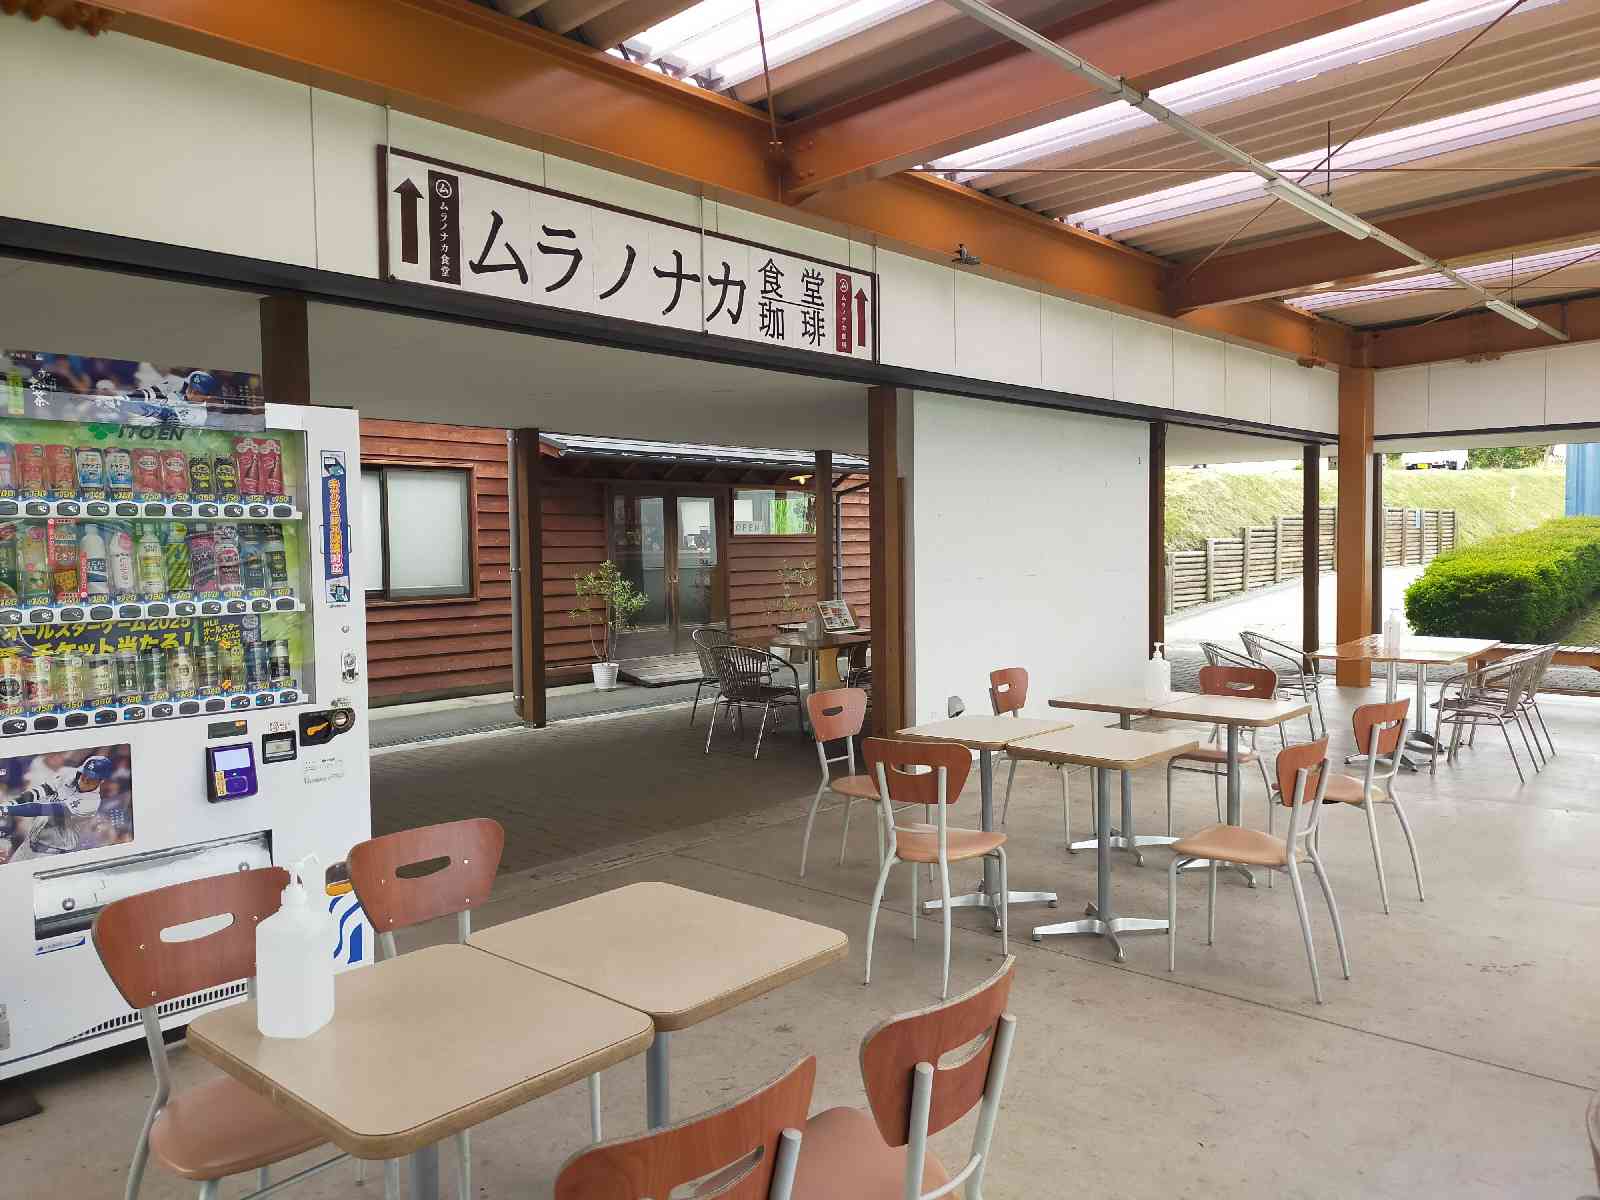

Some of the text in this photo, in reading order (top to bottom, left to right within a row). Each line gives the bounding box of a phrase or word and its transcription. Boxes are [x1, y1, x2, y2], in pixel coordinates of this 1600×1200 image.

[440, 201, 451, 277] ムラノナカ食堂
[468, 210, 747, 325] ムラノナカ
[758, 258, 825, 308] 食堂
[758, 301, 826, 347] 珈琲
